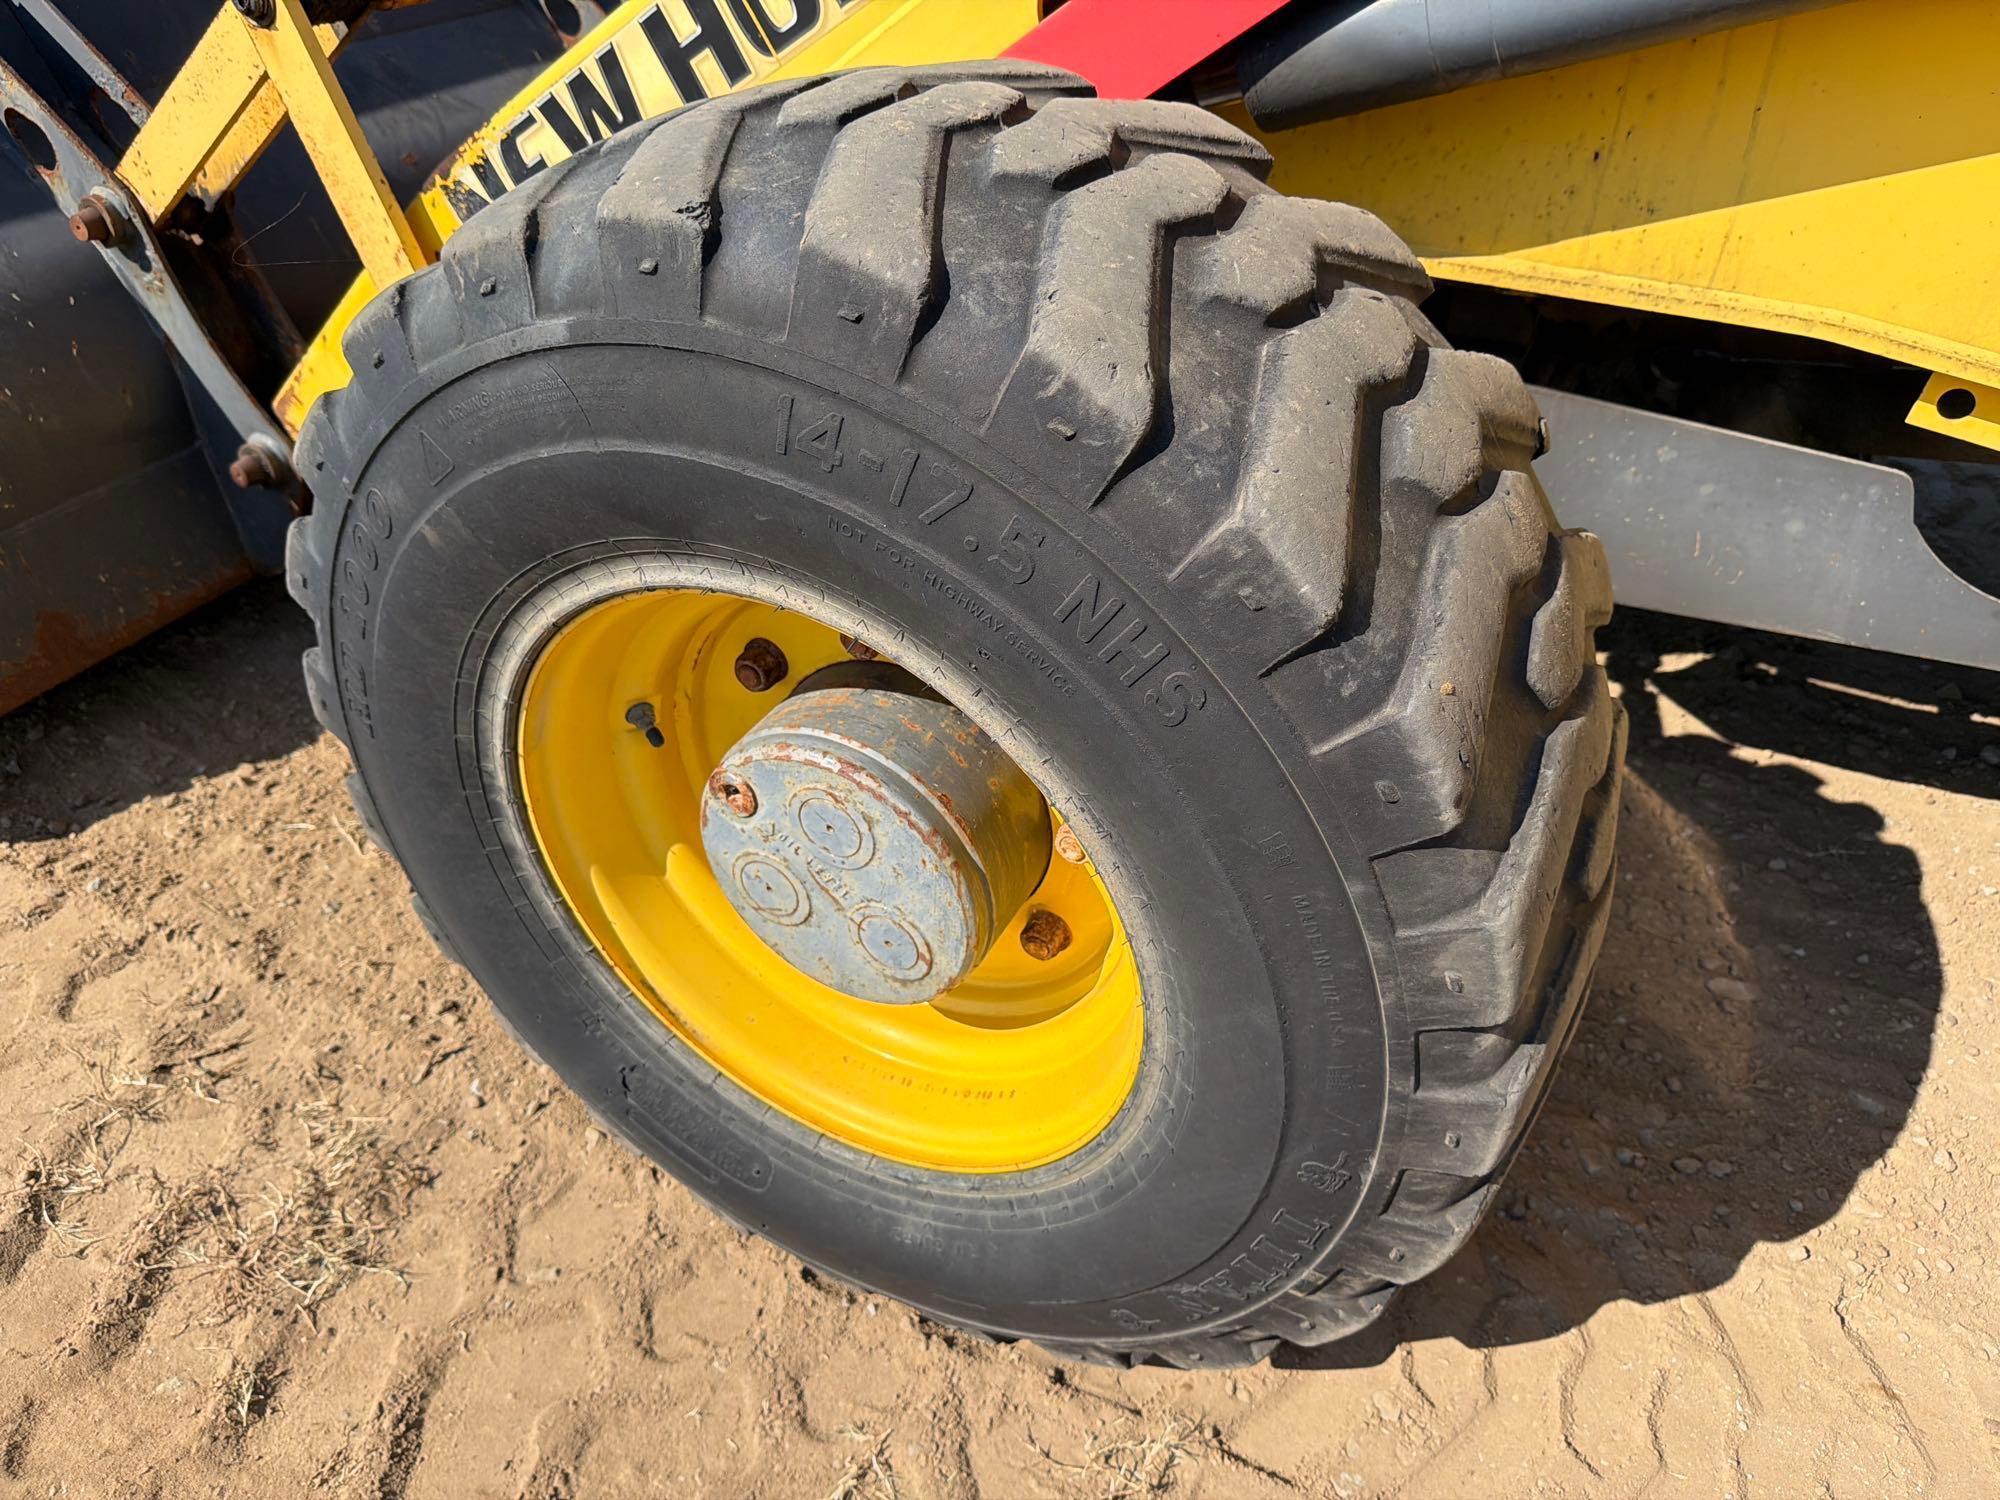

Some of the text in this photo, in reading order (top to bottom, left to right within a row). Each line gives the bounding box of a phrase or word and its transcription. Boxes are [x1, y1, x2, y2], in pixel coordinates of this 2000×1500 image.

[639, 0, 860, 104] HO
[774, 393, 1208, 729] 14-17.5 NHS
[826, 514, 1076, 699] NOT FOR HIGHWAY SERVICE
